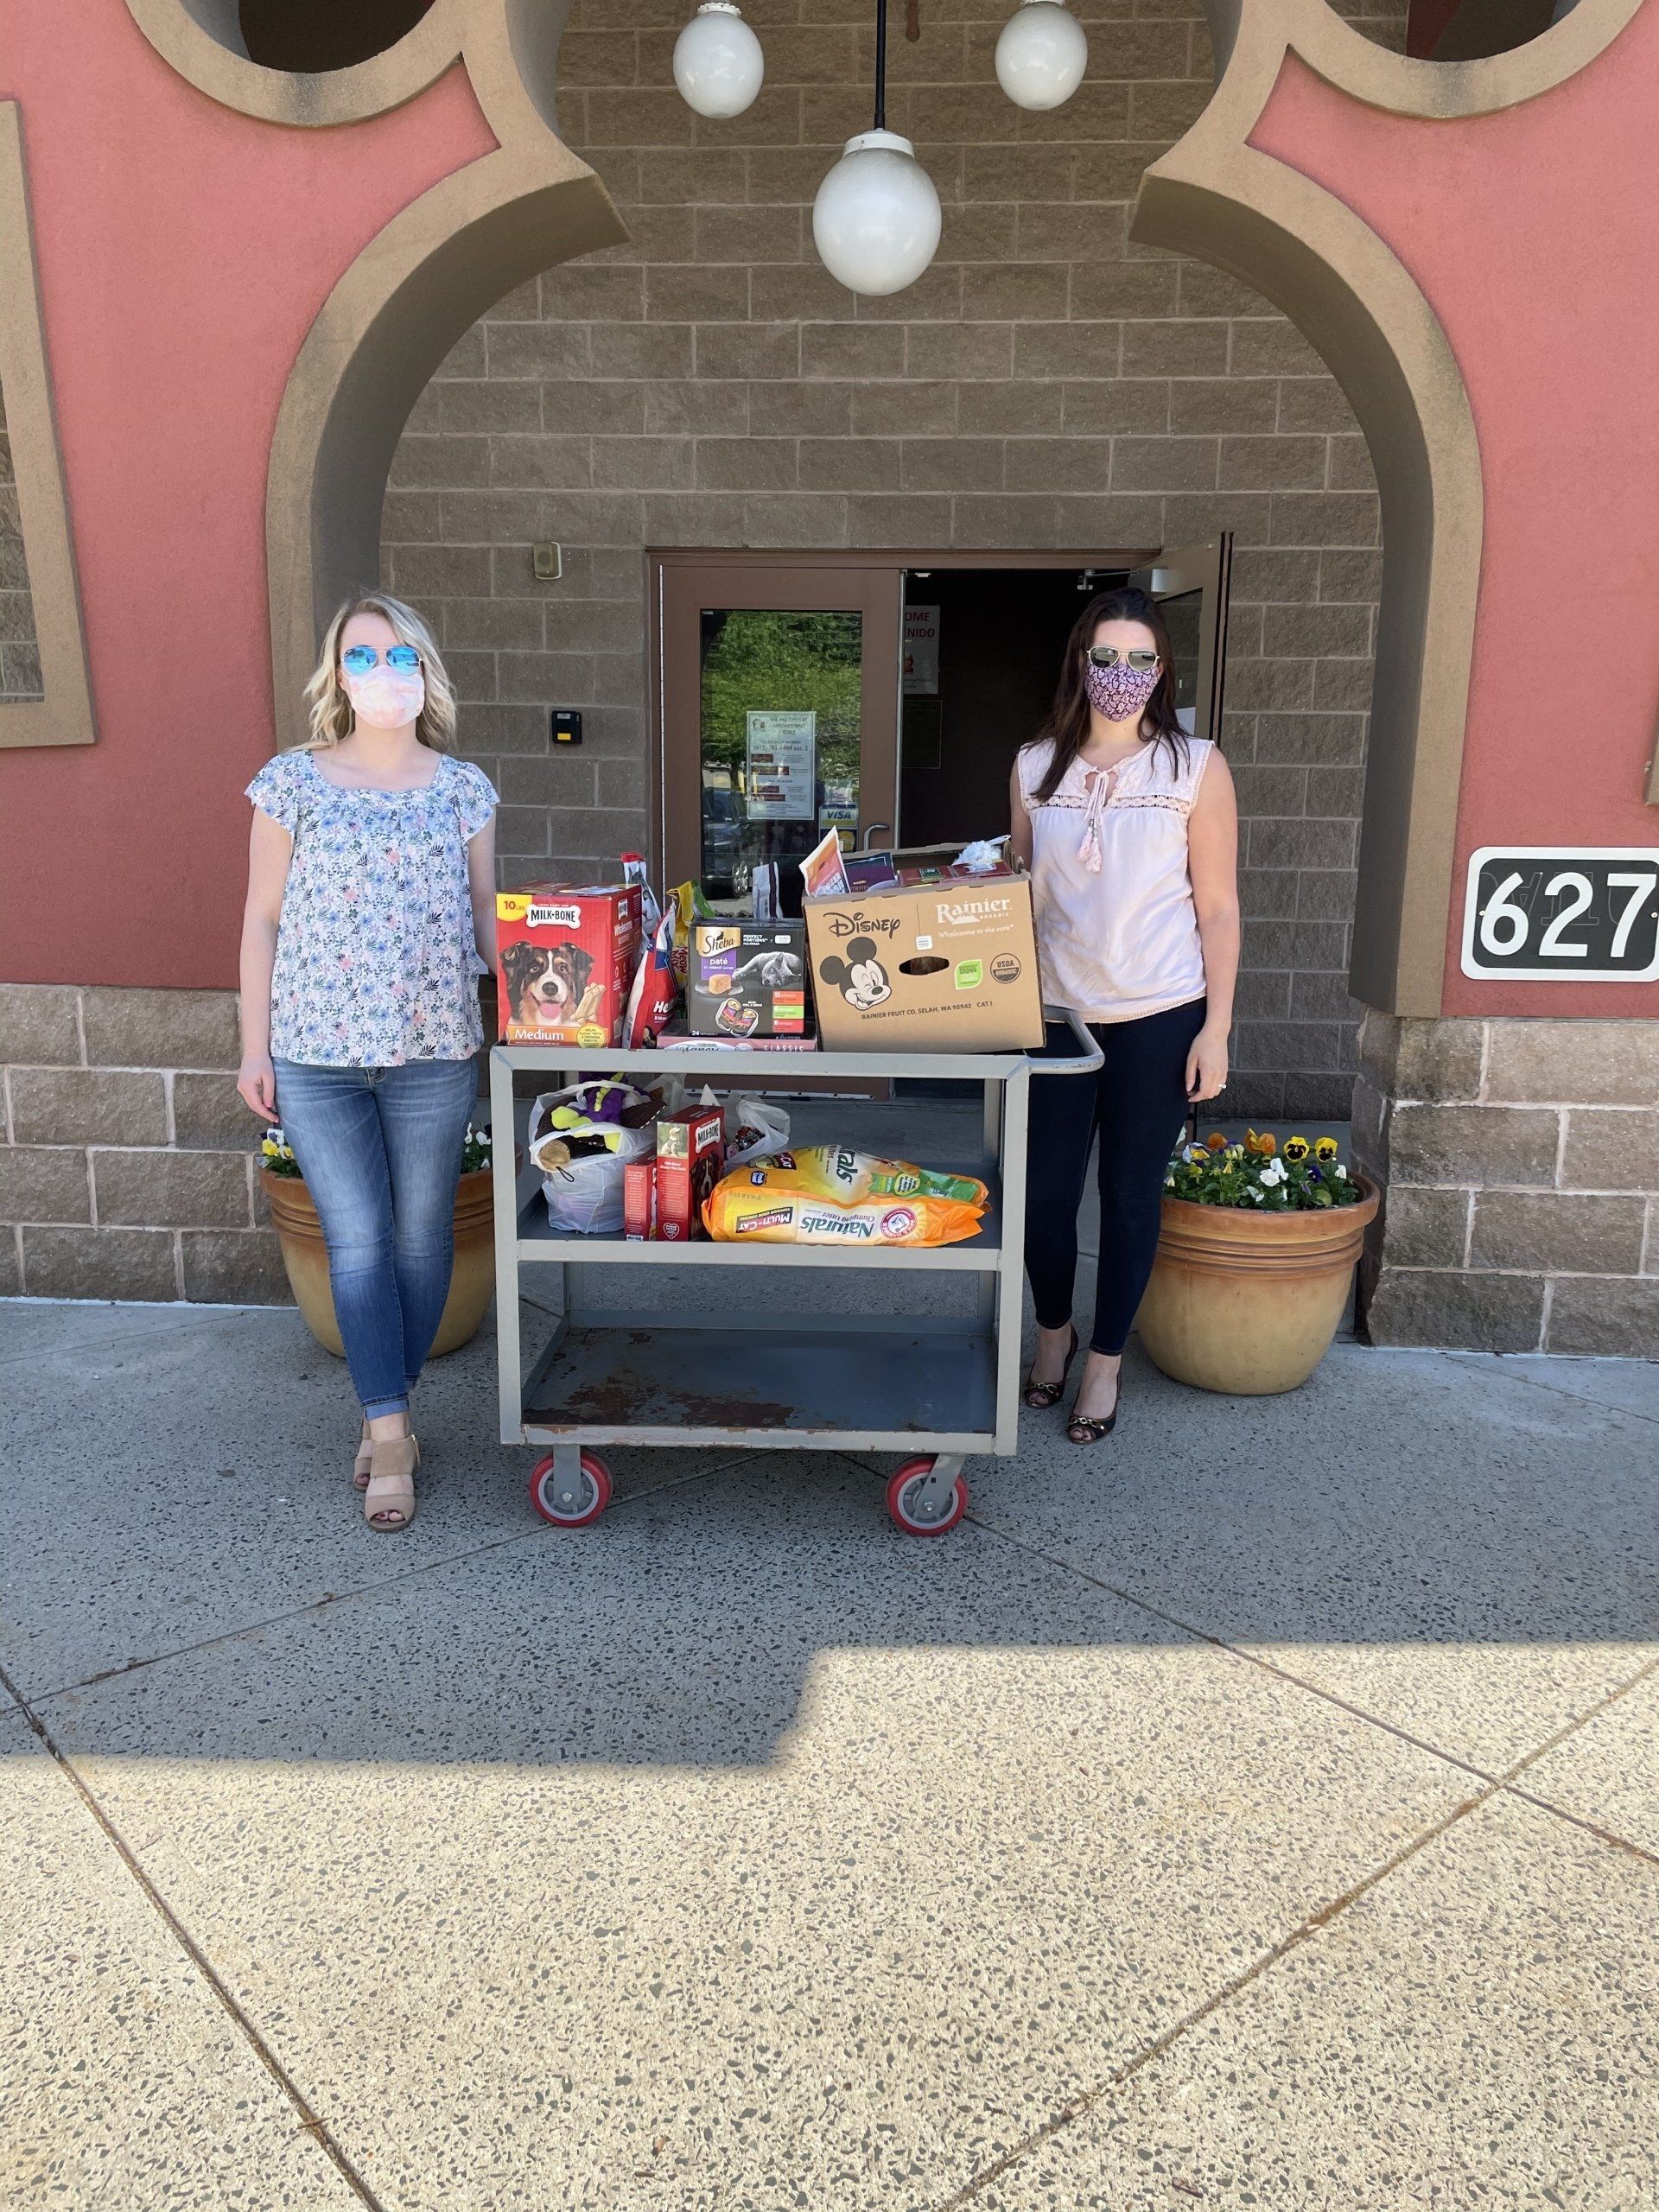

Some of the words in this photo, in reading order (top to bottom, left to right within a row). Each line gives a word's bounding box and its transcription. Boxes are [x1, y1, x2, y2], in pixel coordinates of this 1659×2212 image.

[905, 628, 935, 638] NIDO
[827, 810, 851, 819] VISA
[504, 900, 516, 910] 10
[936, 899, 1012, 924] Rainier
[531, 909, 575, 923] MILK-BONE
[1480, 872, 1656, 957] 627
[939, 930, 976, 938] Wholesome
[702, 935, 734, 954] Sheba
[678, 947, 689, 973] Meow
[709, 957, 728, 966] paté
[515, 1028, 563, 1041] Medium
[836, 1147, 858, 1183] rals
[800, 1217, 874, 1237] Naturals
